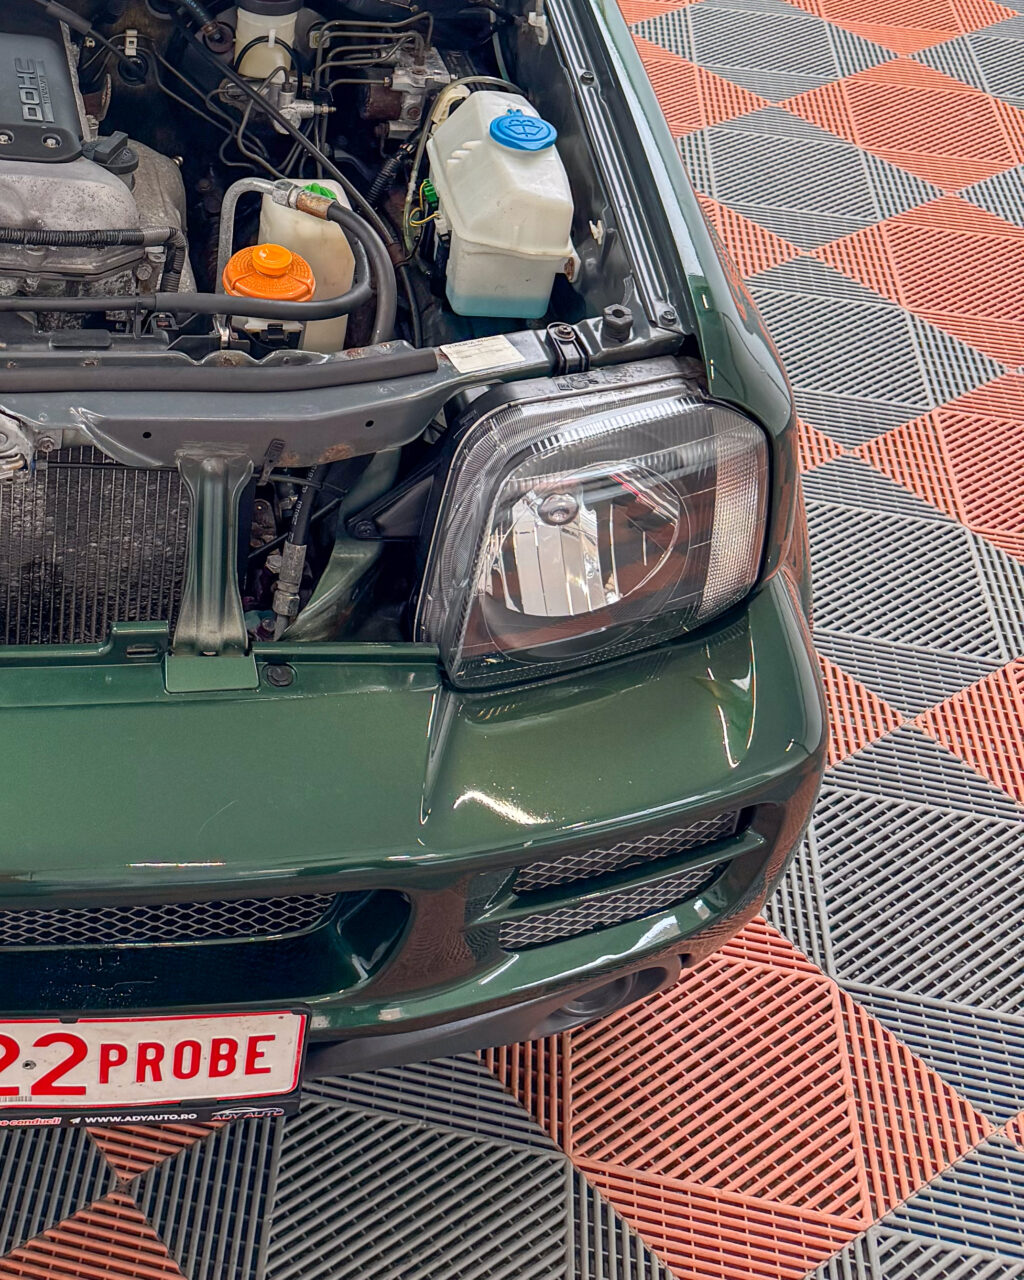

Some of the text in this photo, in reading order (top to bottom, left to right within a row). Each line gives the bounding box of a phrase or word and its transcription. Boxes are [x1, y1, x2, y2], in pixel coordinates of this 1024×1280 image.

[15, 58, 44, 122] DOHC
[99, 1034, 276, 1084] PROBE
[84, 1113, 197, 1123] WWW.ADYAUTO.RO
